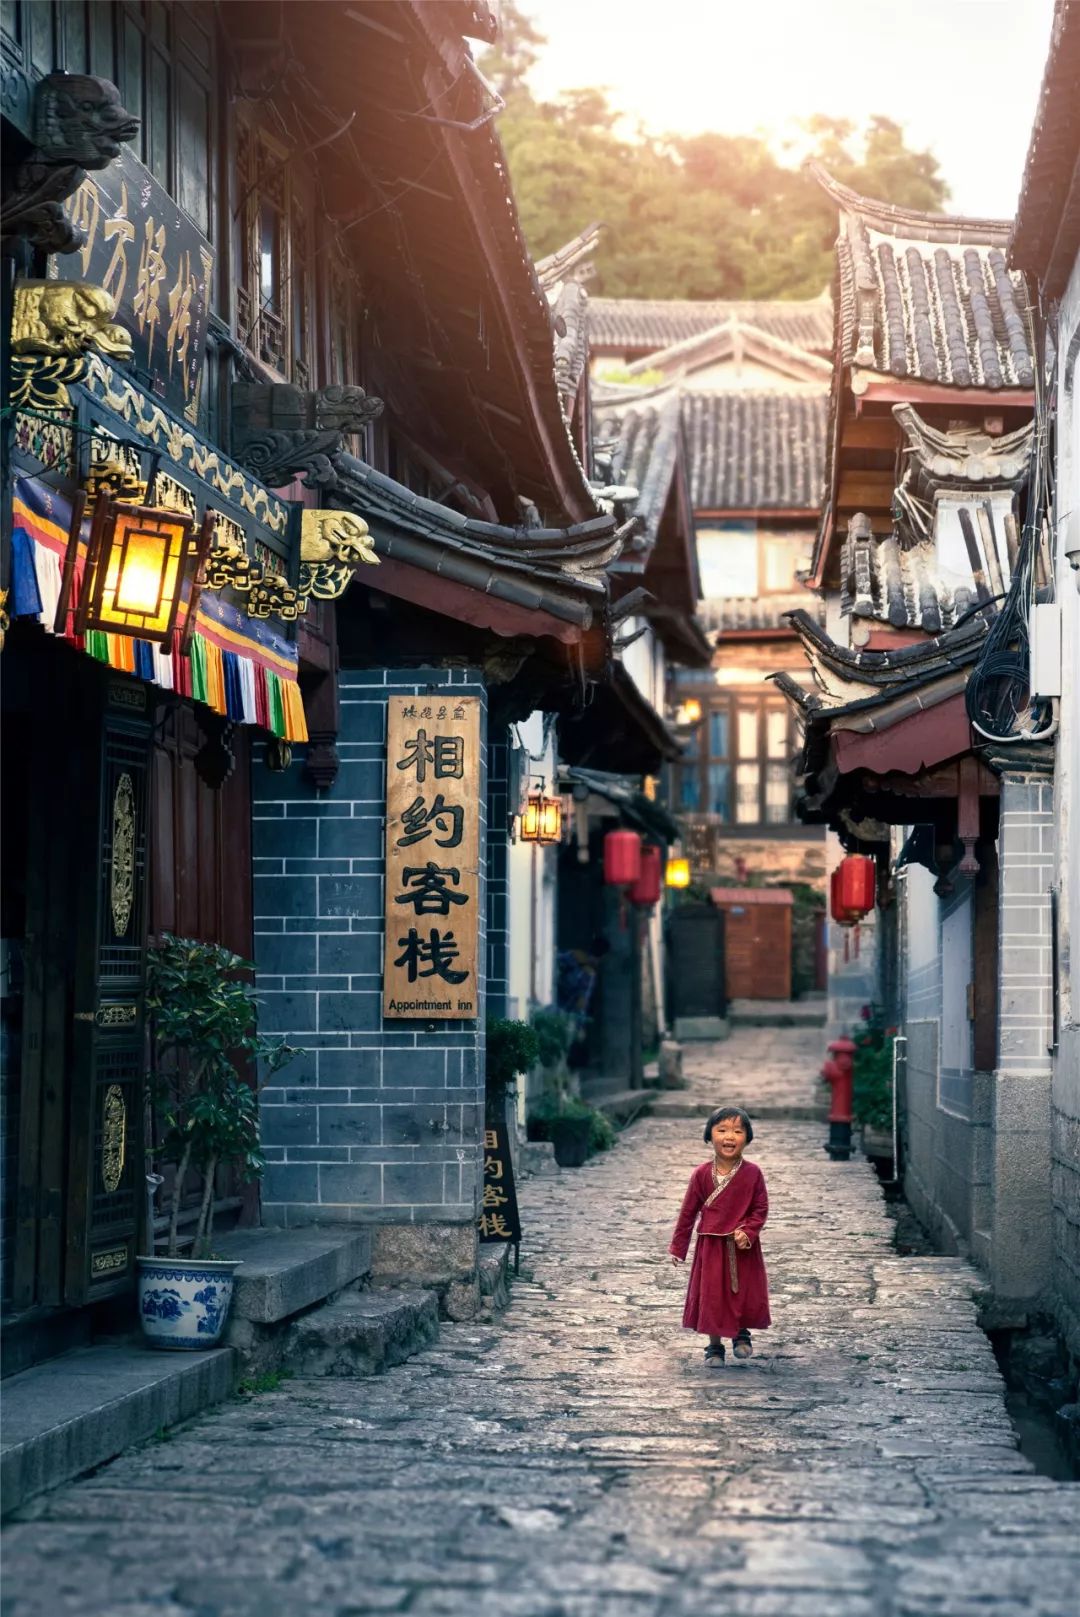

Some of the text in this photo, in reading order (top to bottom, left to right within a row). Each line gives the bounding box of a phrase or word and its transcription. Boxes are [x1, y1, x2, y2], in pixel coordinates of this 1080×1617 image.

[394, 728, 470, 985] 相约客栈
[388, 999, 473, 1012] Appointment inn
